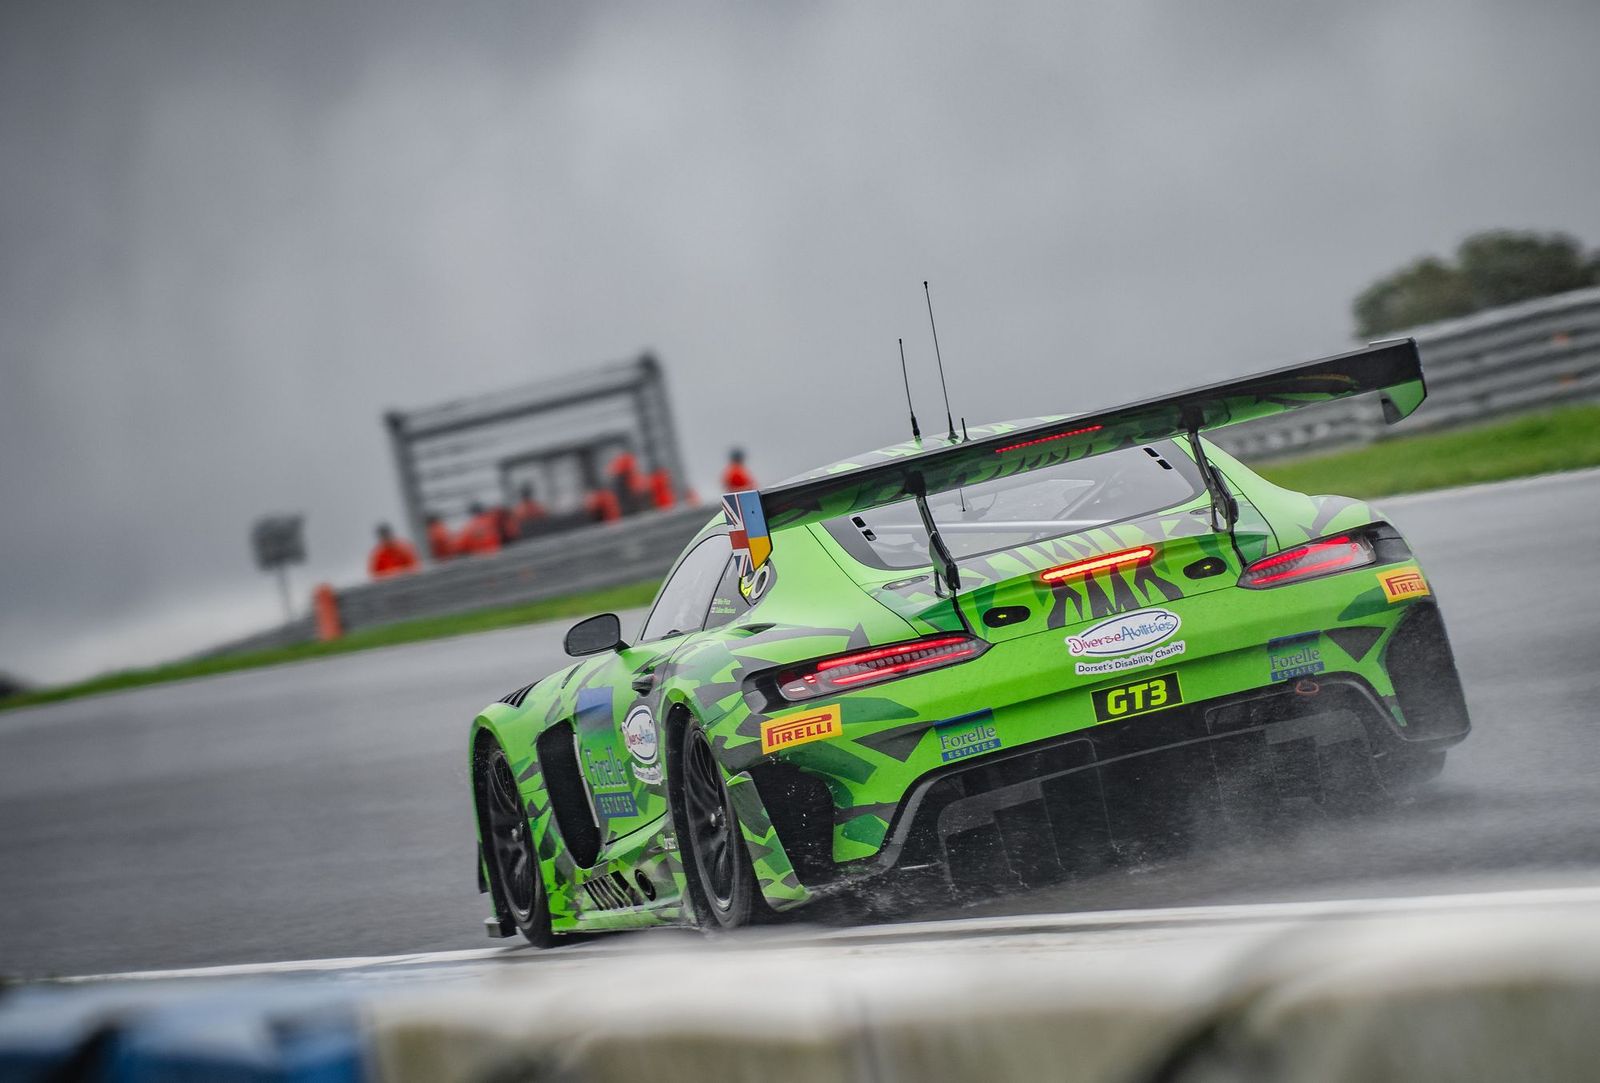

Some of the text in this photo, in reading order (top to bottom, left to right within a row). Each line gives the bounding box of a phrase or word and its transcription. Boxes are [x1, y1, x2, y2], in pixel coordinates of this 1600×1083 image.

[1078, 643, 1184, 673] Dorset's Disability Charity
[1270, 647, 1320, 670] Forelle
[1107, 679, 1168, 715] GT3
[766, 713, 833, 747] PIRELLI
[940, 725, 996, 750] Forelle
[948, 740, 995, 759] ESTATES
[584, 745, 628, 788] Forelle
